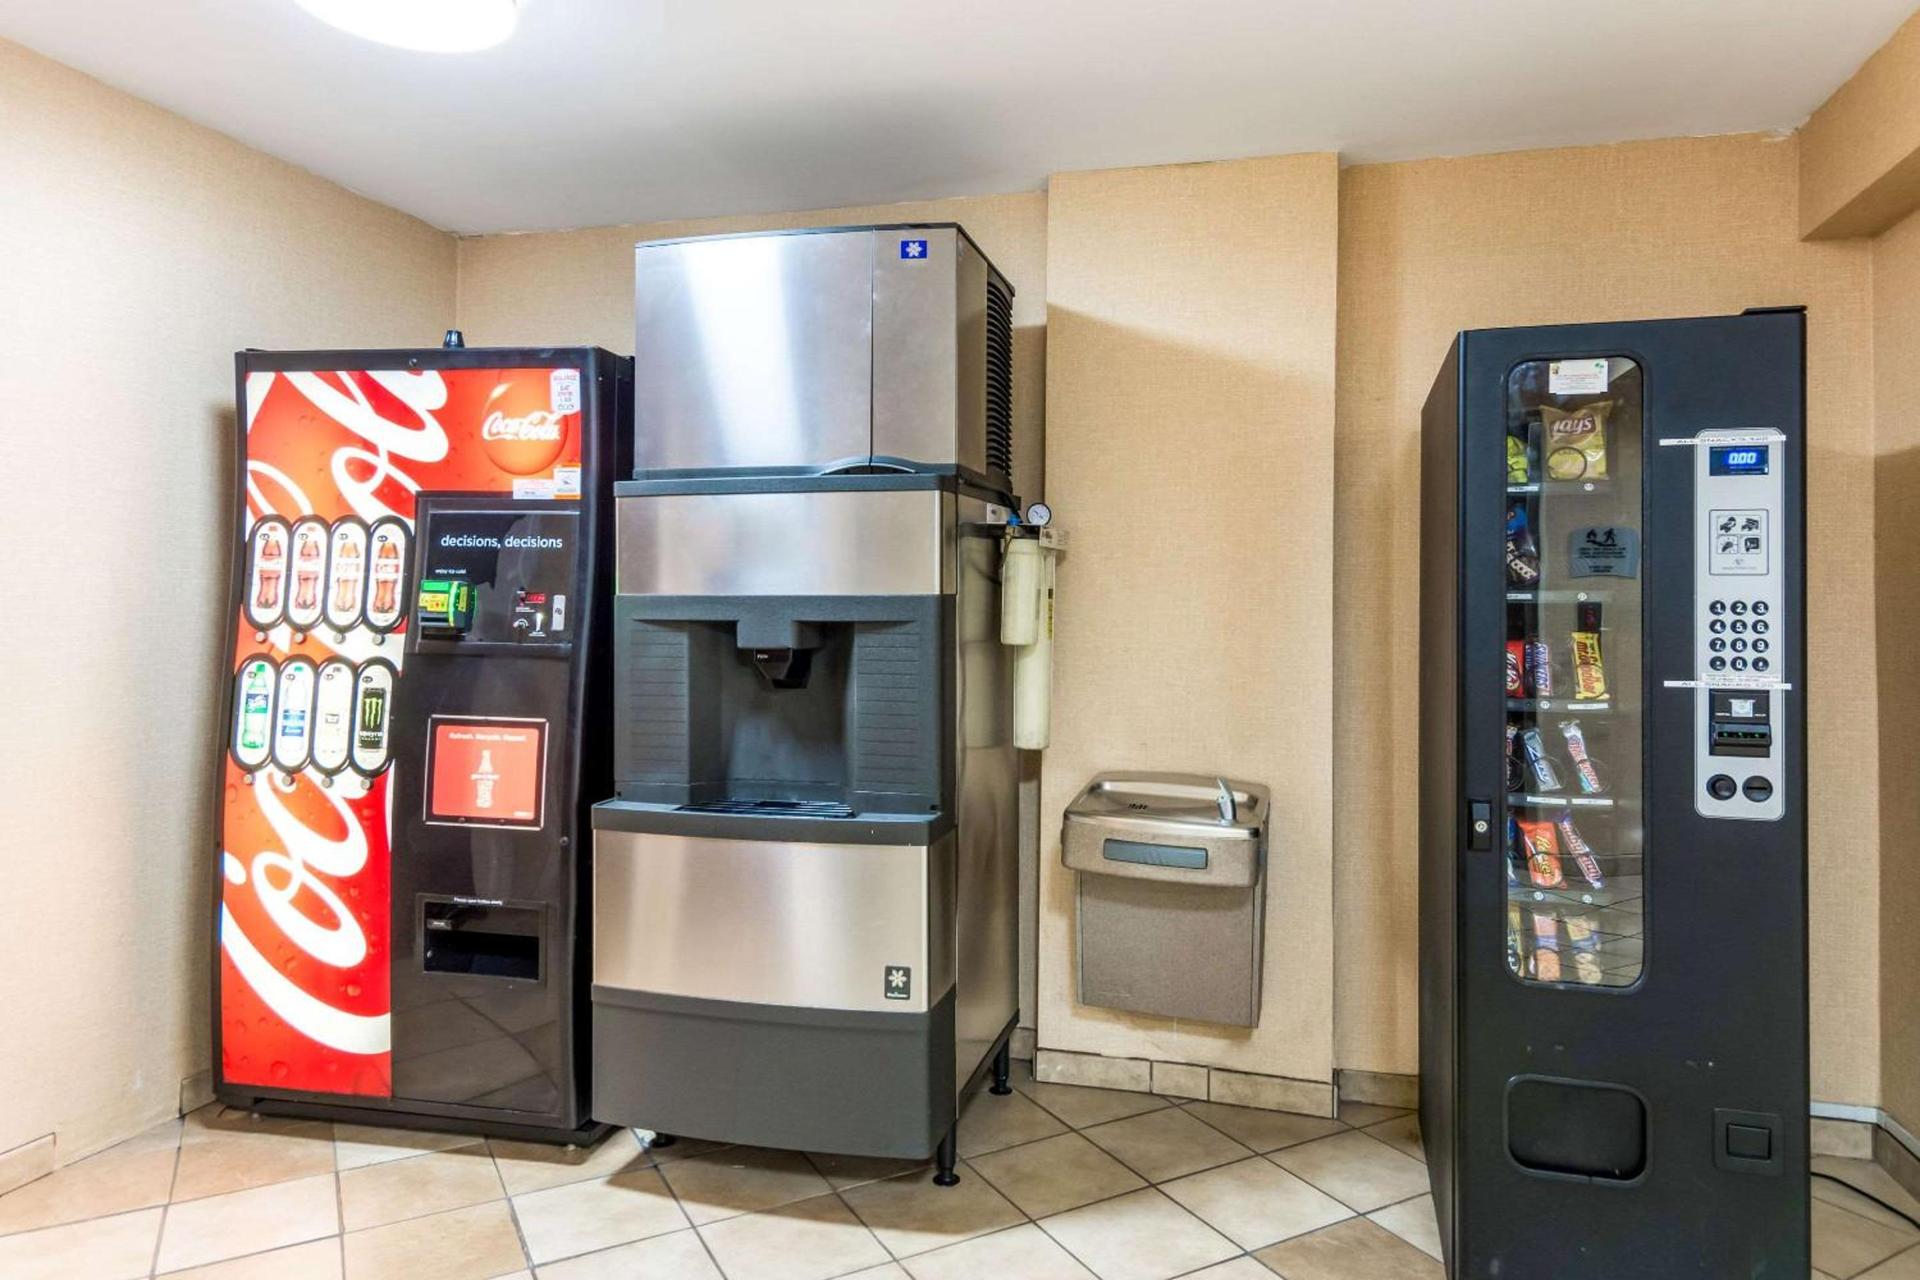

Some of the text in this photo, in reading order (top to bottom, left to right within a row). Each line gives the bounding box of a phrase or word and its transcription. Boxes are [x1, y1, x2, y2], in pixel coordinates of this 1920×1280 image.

[481, 410, 563, 441] Coca-Cola
[440, 534, 563, 549] decisions, decisions
